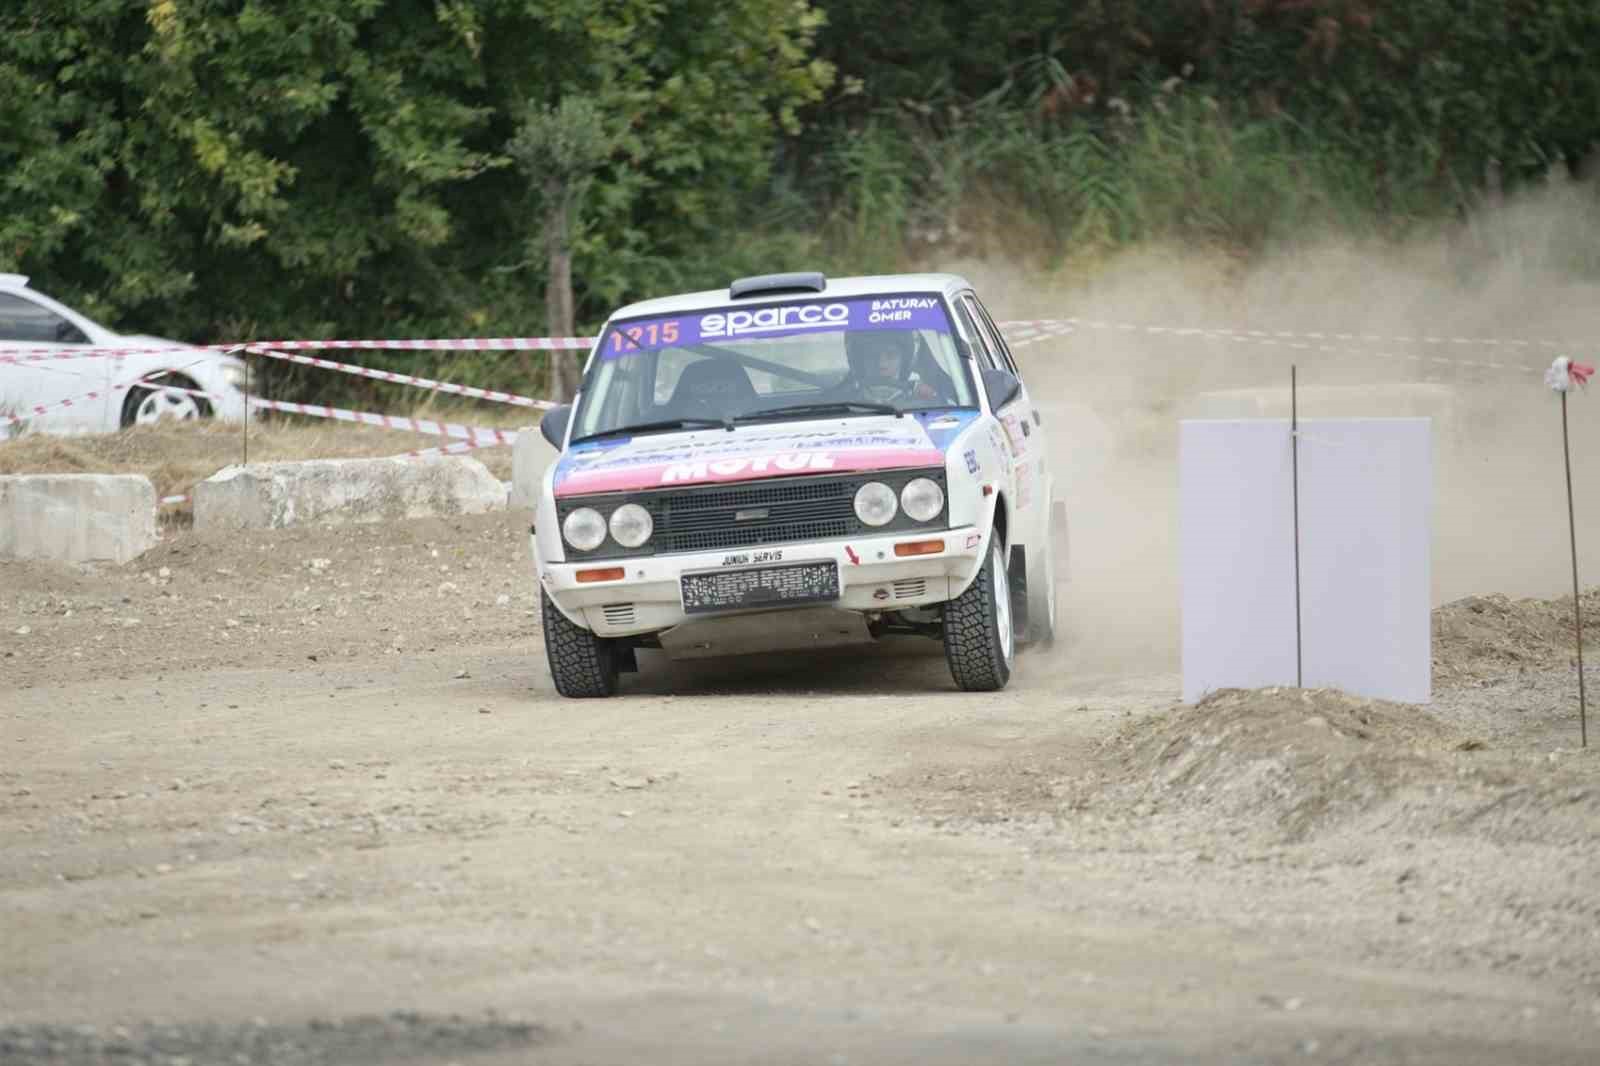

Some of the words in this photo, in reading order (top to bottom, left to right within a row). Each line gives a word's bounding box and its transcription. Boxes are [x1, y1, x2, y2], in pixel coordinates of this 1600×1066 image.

[700, 303, 849, 337] sparco
[871, 298, 938, 311] BATURAY
[609, 321, 680, 353] 1215
[660, 450, 837, 483] MOTUL
